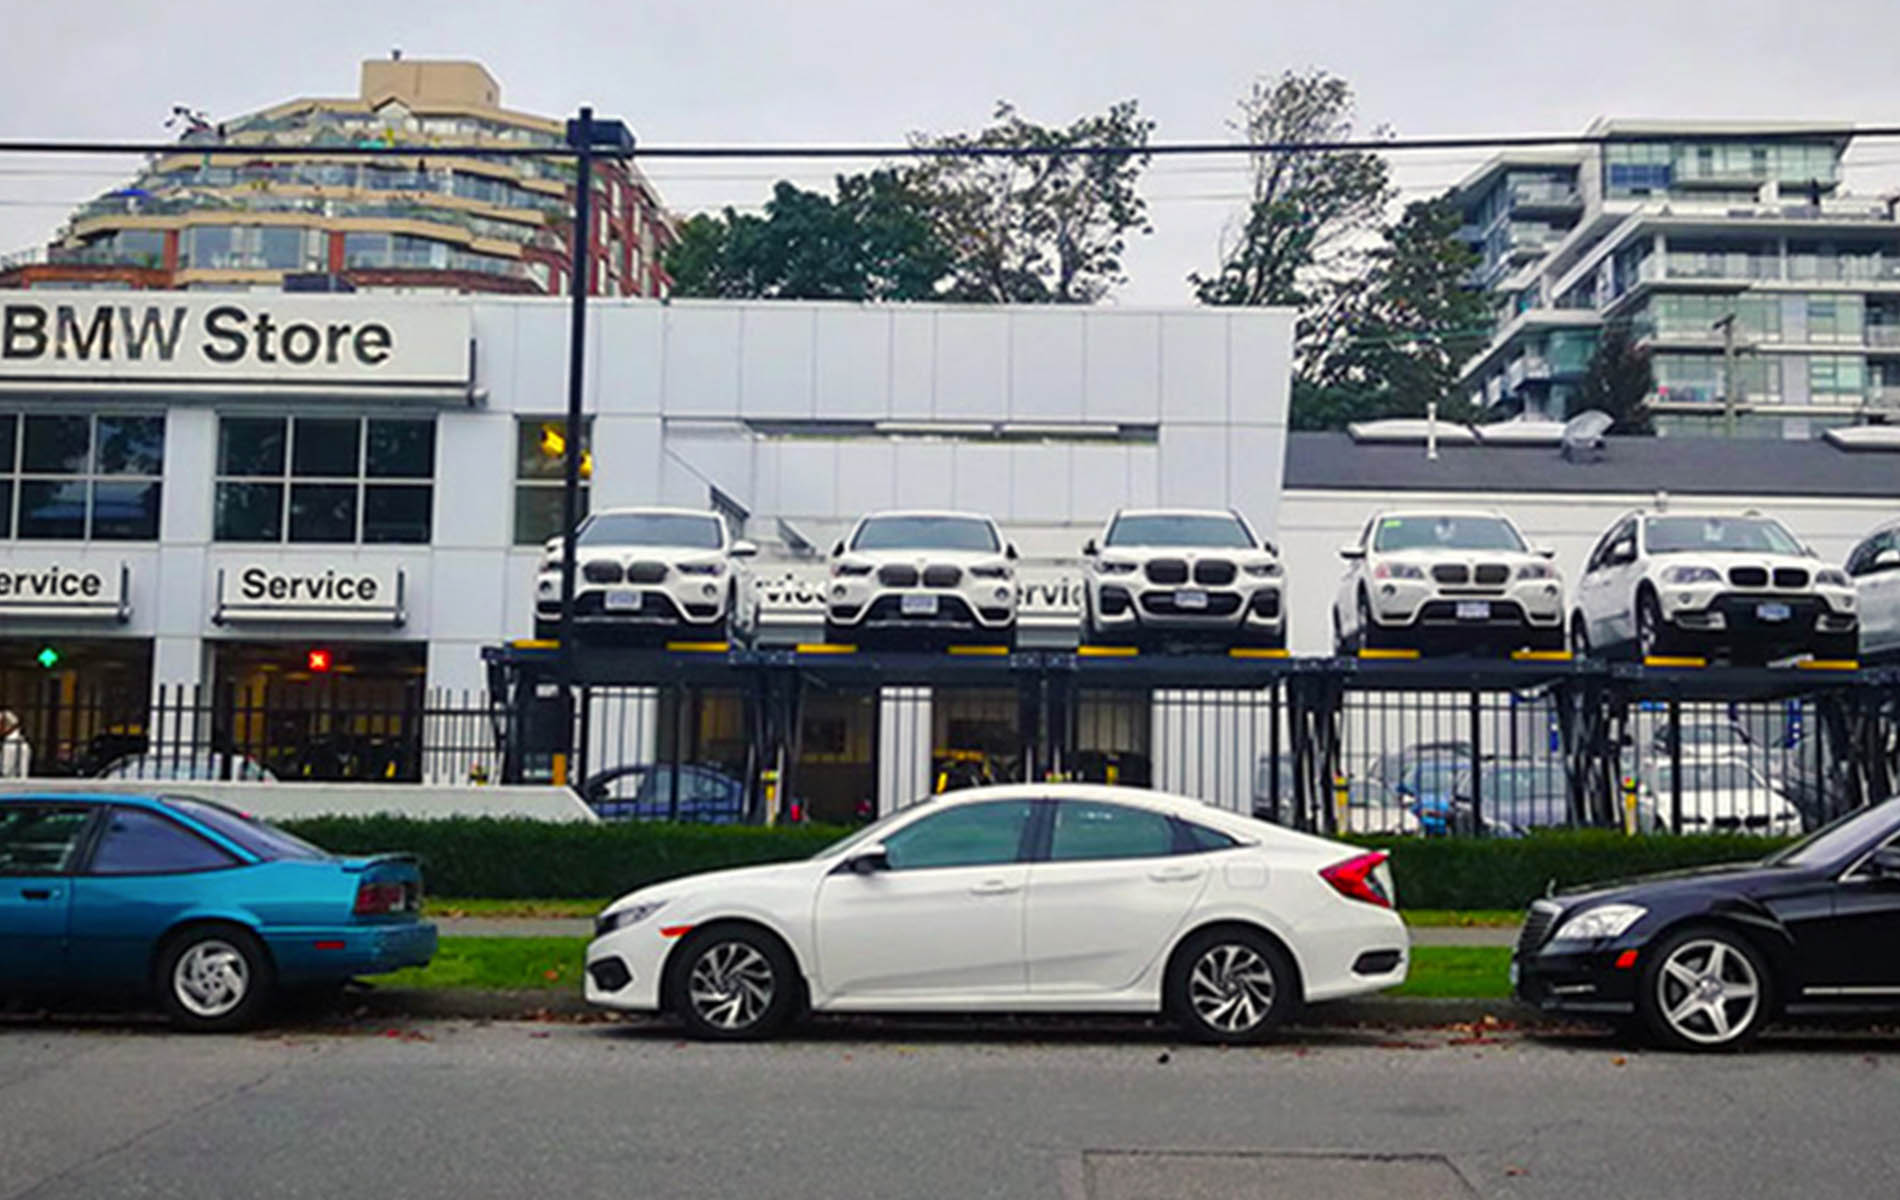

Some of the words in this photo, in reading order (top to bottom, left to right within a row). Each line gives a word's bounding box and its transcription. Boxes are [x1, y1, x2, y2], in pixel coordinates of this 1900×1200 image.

[2, 305, 187, 361] BMW
[202, 306, 392, 365] Store
[242, 568, 378, 600] Service
